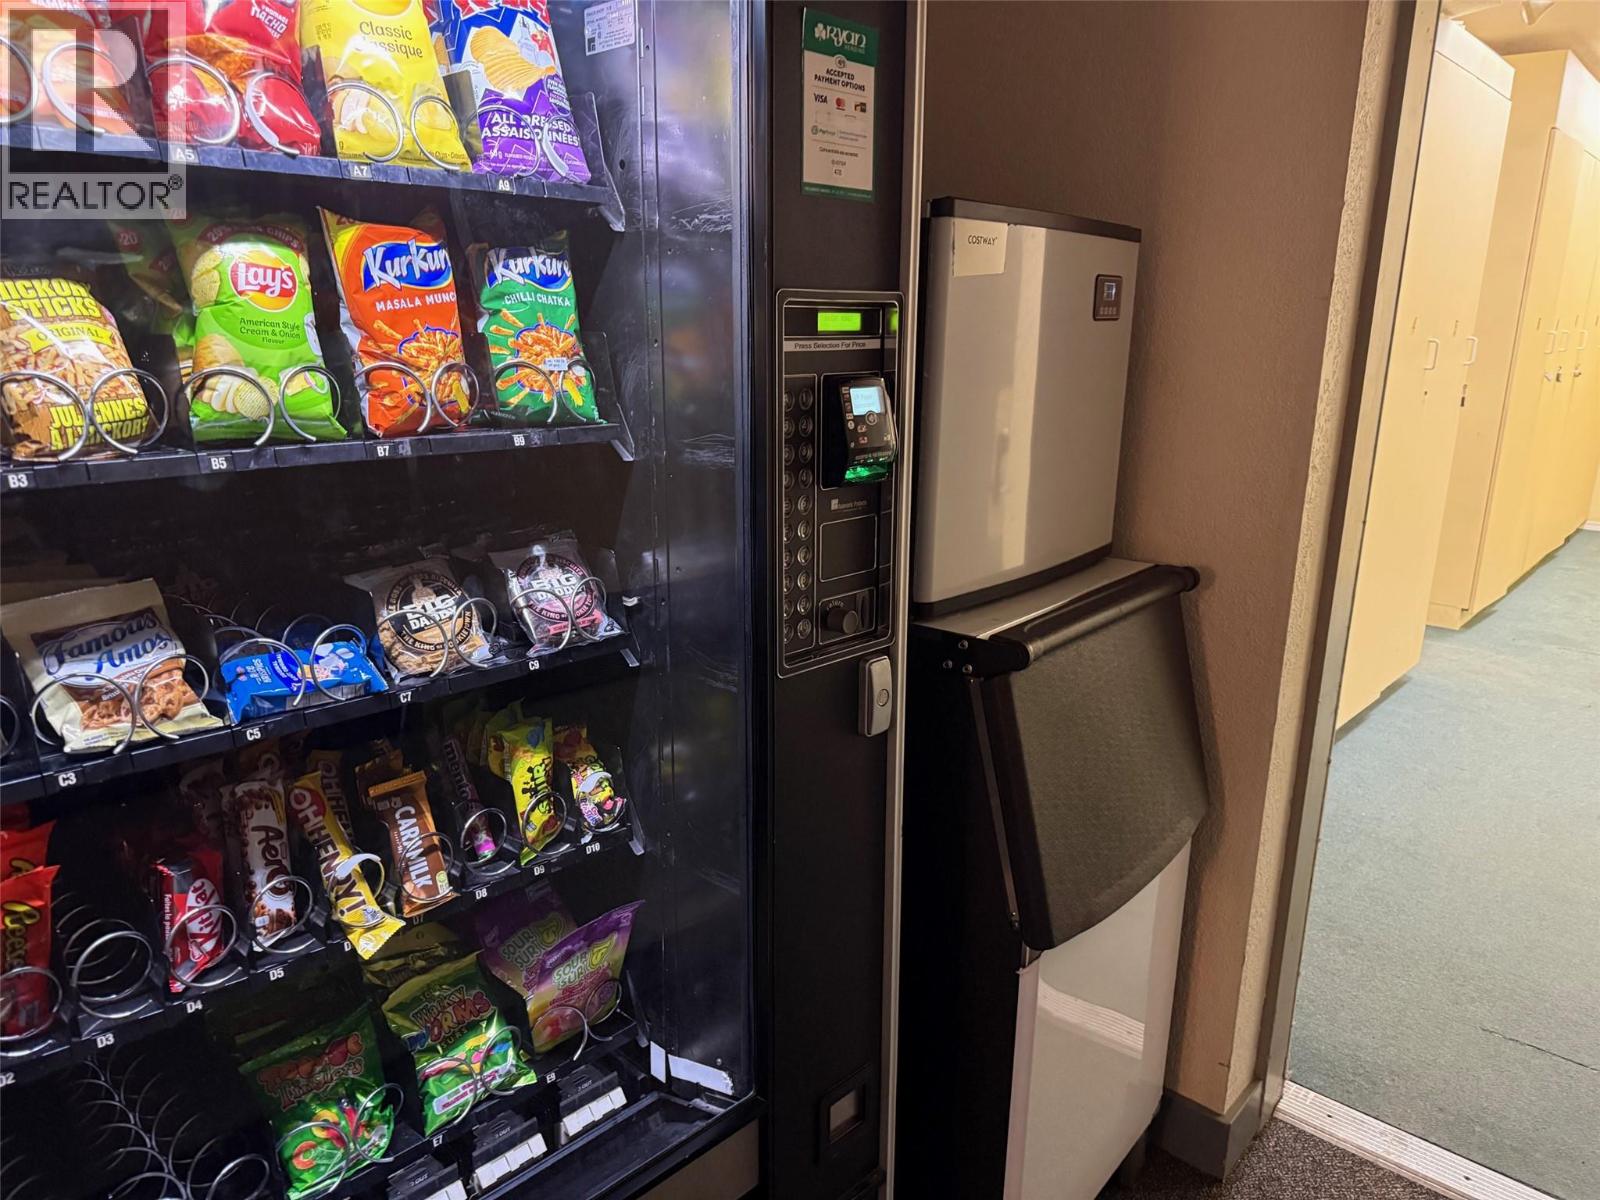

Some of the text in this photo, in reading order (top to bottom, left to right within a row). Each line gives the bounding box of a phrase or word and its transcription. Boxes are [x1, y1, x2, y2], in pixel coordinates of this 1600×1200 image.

[251, 5, 288, 34] NACHO
[359, 20, 413, 41] Classic
[826, 24, 867, 48] Ryan
[360, 35, 423, 60] ssique
[825, 67, 855, 81] ACCEPTED
[814, 73, 866, 92] PAYMENT OPTIONS
[813, 92, 828, 105] VISA
[491, 111, 517, 125] ALL
[175, 148, 195, 161] A5
[353, 165, 368, 177] A7
[498, 180, 511, 192] A9
[362, 238, 452, 292] Kurkur
[238, 262, 294, 298] Lay's
[375, 291, 457, 313] MASALA MUNC
[504, 291, 572, 307] CHILLI CHATKA
[5, 296, 101, 321] STICKS
[239, 317, 300, 332] American Style
[239, 326, 301, 339] Cream & Onion
[794, 342, 813, 350] Press
[813, 342, 840, 350] Selection
[851, 341, 866, 349] Price
[49, 397, 147, 428] JULENNES
[513, 435, 526, 447] B9
[376, 445, 390, 458] B7
[211, 457, 227, 470] B5
[8, 473, 29, 488] B3
[43, 614, 158, 676] Famous
[414, 642, 436, 651] KING
[95, 632, 173, 674] Amos
[528, 660, 540, 671] C9
[400, 691, 412, 704] C7
[246, 728, 261, 741] C5
[58, 772, 77, 787] C3
[585, 842, 601, 855] D10
[251, 825, 292, 896] Aero
[534, 865, 545, 876] D9
[475, 888, 488, 900] D8
[269, 968, 284, 981] D5
[186, 1000, 203, 1013] D4
[97, 1033, 115, 1048] D3
[546, 1072, 556, 1083] E9
[432, 1134, 444, 1147] E7
